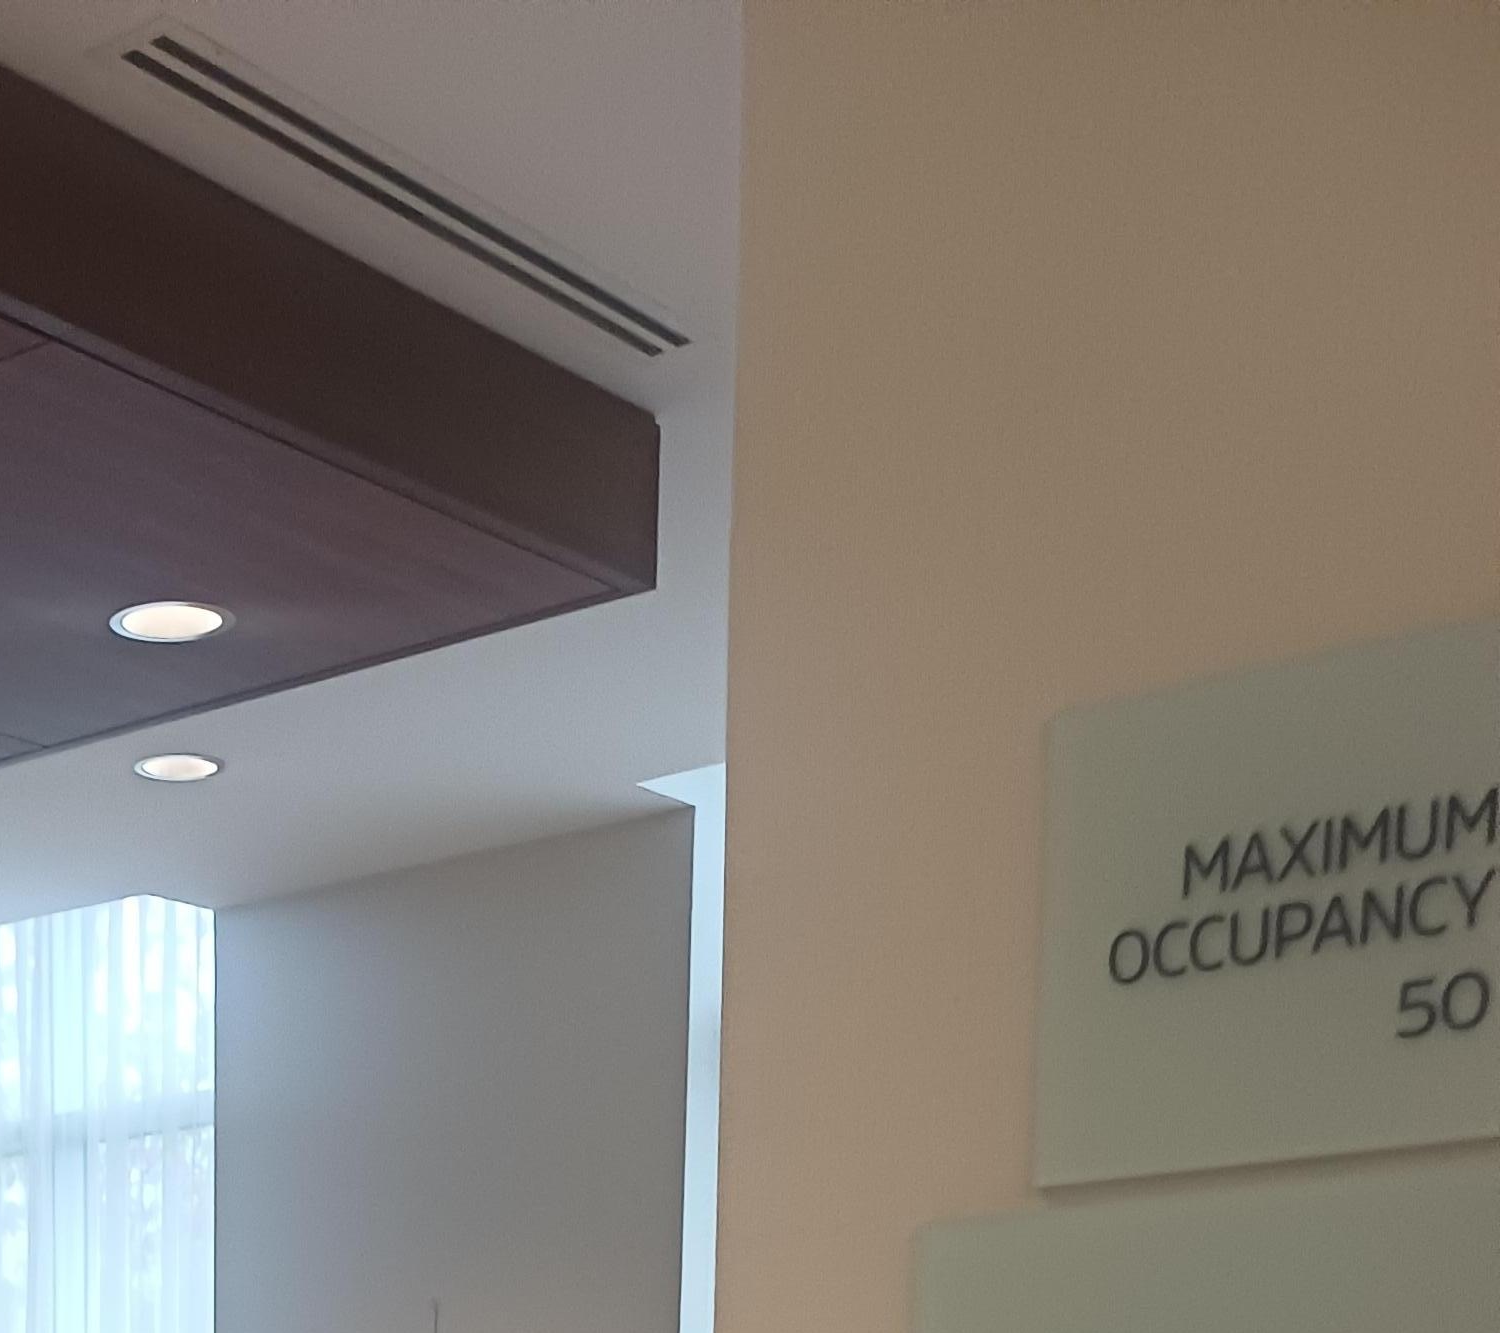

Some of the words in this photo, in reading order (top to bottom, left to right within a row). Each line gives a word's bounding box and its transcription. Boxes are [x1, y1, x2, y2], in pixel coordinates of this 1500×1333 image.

[1182, 784, 1500, 900] MAXIMUM
[1108, 866, 1499, 987] OCCUPANCY
[1395, 969, 1493, 1041] 50
